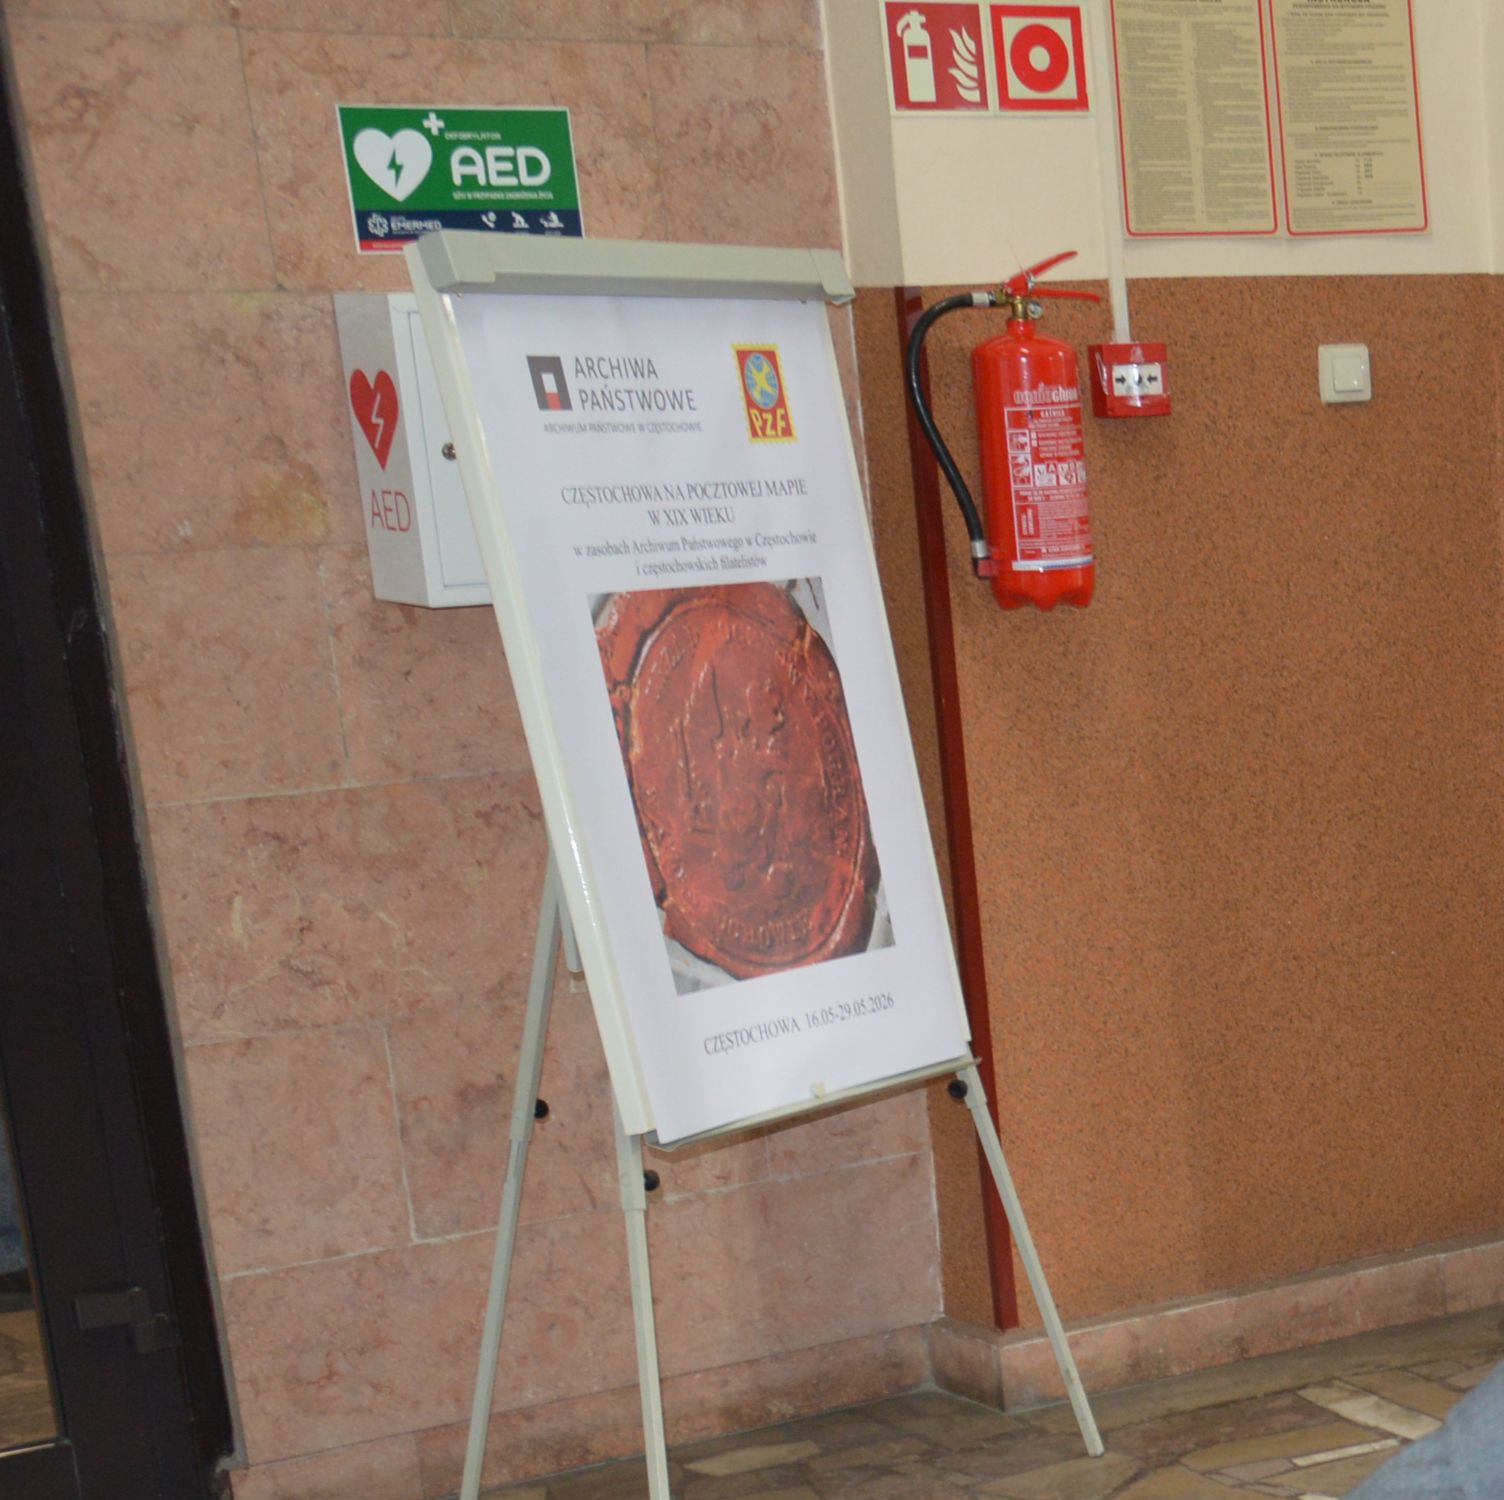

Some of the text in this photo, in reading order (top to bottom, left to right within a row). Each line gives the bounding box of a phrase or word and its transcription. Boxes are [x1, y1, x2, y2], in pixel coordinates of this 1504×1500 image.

[450, 145, 551, 187] AED
[574, 356, 659, 380] ARCHIWA
[578, 384, 698, 412] PAŃSTWOWE
[749, 408, 788, 438] PZF
[561, 478, 808, 508] CZĘSTOCHOWA NA POCZTOWEJ MAPIE
[370, 489, 411, 533] AED
[648, 507, 736, 526] W XIX WIEKU
[586, 540, 631, 557] zasobach
[633, 537, 681, 555] Archiwum
[682, 535, 744, 553] Państwowego
[704, 991, 894, 1057] CZĘSTOCHOWA 16.05-29.05.2026
